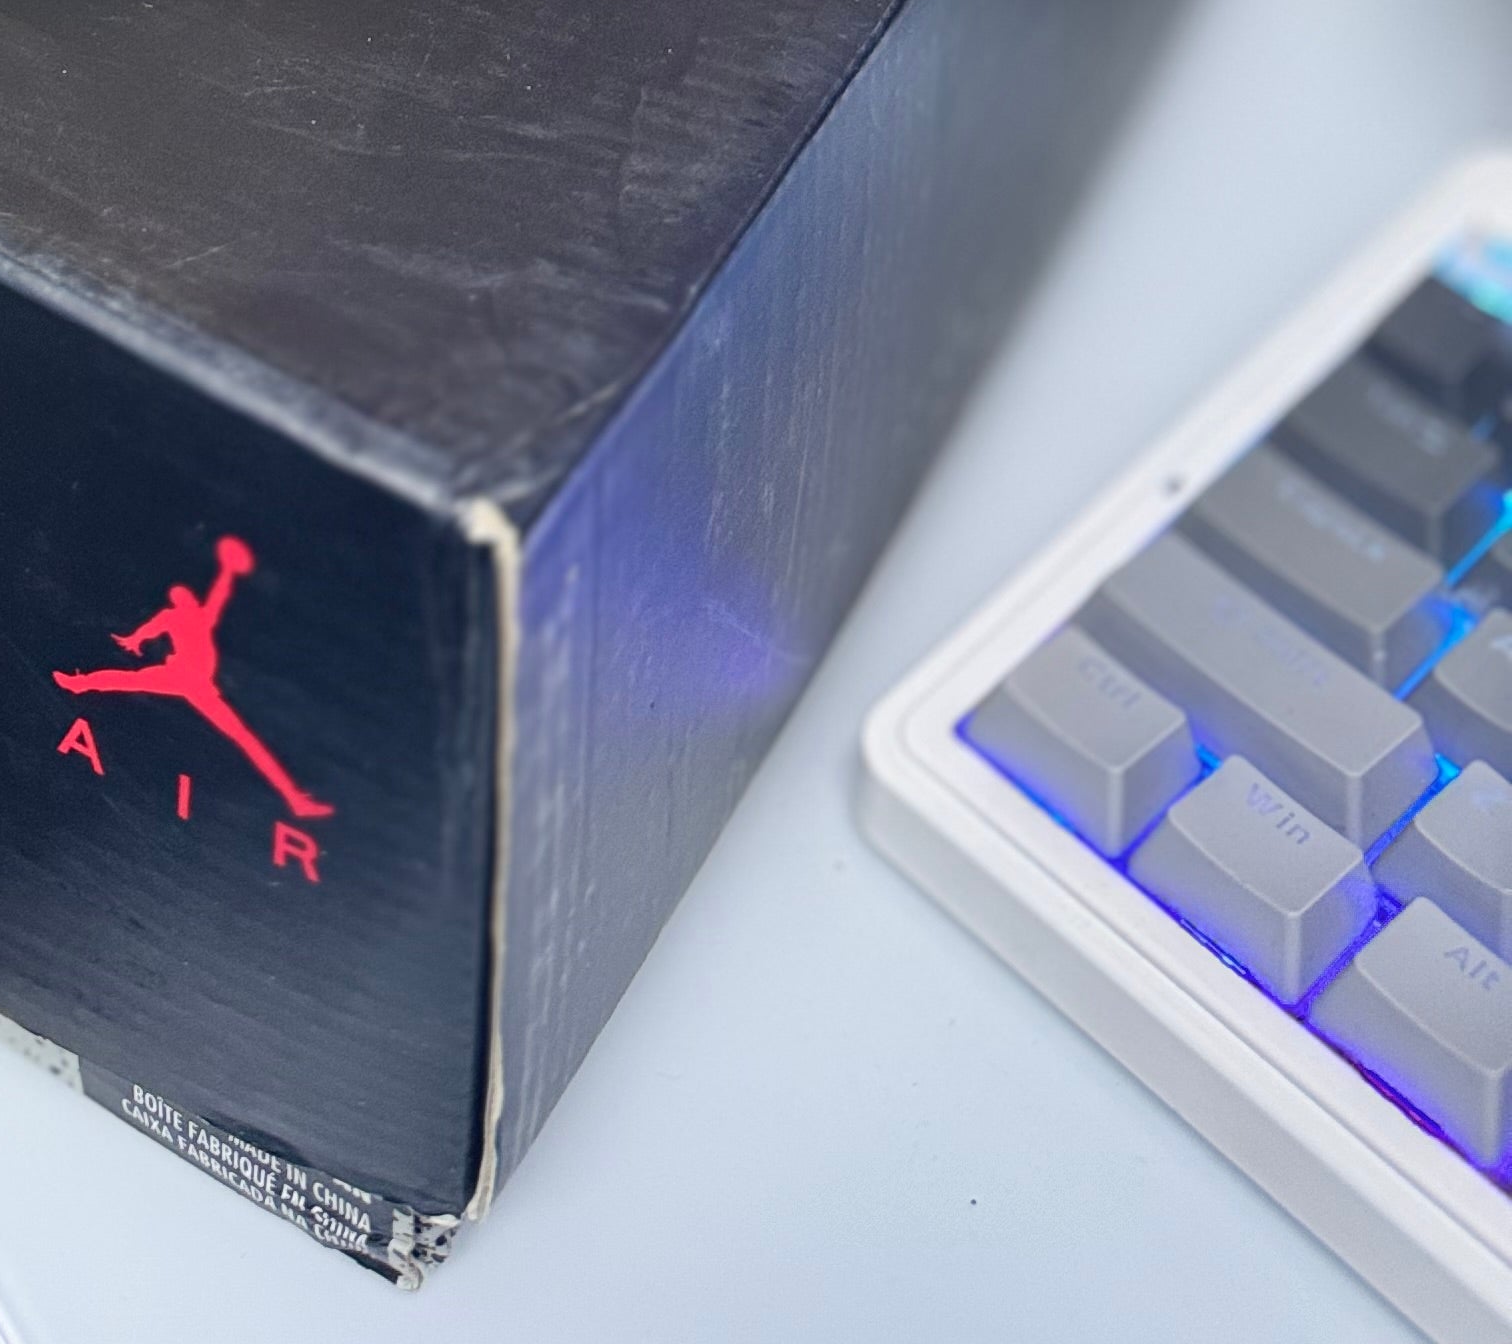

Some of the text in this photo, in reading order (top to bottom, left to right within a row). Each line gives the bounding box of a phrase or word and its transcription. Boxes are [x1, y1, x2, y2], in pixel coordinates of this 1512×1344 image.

[1246, 782, 1311, 845] Win
[1444, 945, 1501, 992] Alt
[121, 1098, 173, 1144] CAIXA
[177, 1134, 277, 1211] FABRICADA
[133, 1084, 183, 1132] BOÎTE
[188, 1120, 276, 1196] FABRIQUÉ
[286, 1163, 307, 1191] IN
[312, 1182, 372, 1233] CHINA
